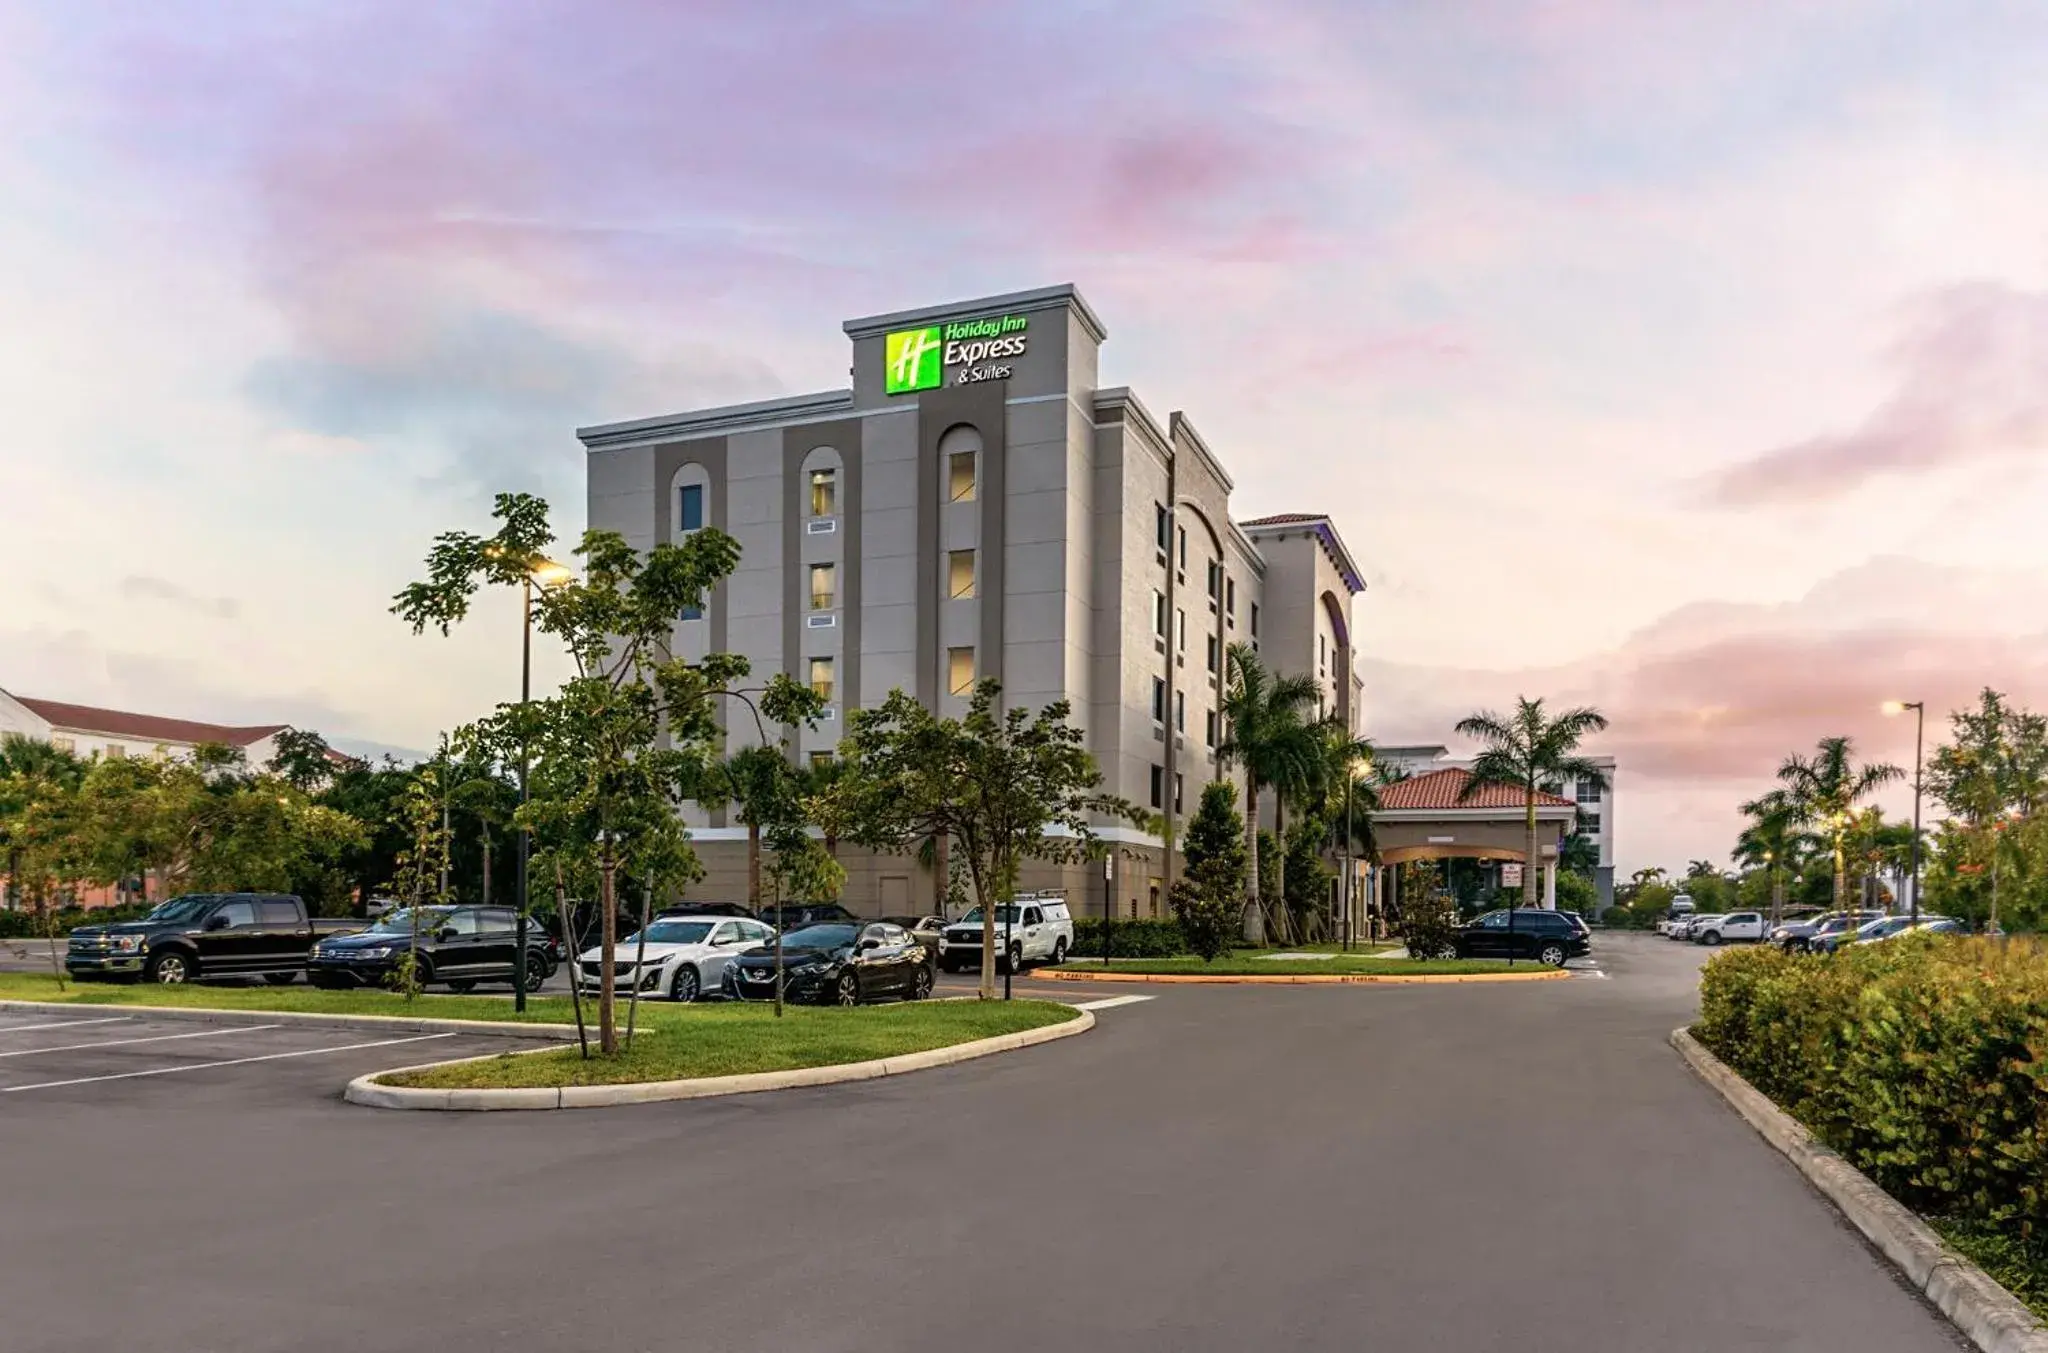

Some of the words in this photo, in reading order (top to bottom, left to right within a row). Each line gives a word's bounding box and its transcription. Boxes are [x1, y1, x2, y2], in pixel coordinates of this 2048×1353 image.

[945, 320, 1000, 340] Holiday
[1002, 315, 1026, 332] Inn
[944, 335, 1026, 367] Express
[958, 369, 968, 383] &
[971, 365, 1010, 382] Suites
